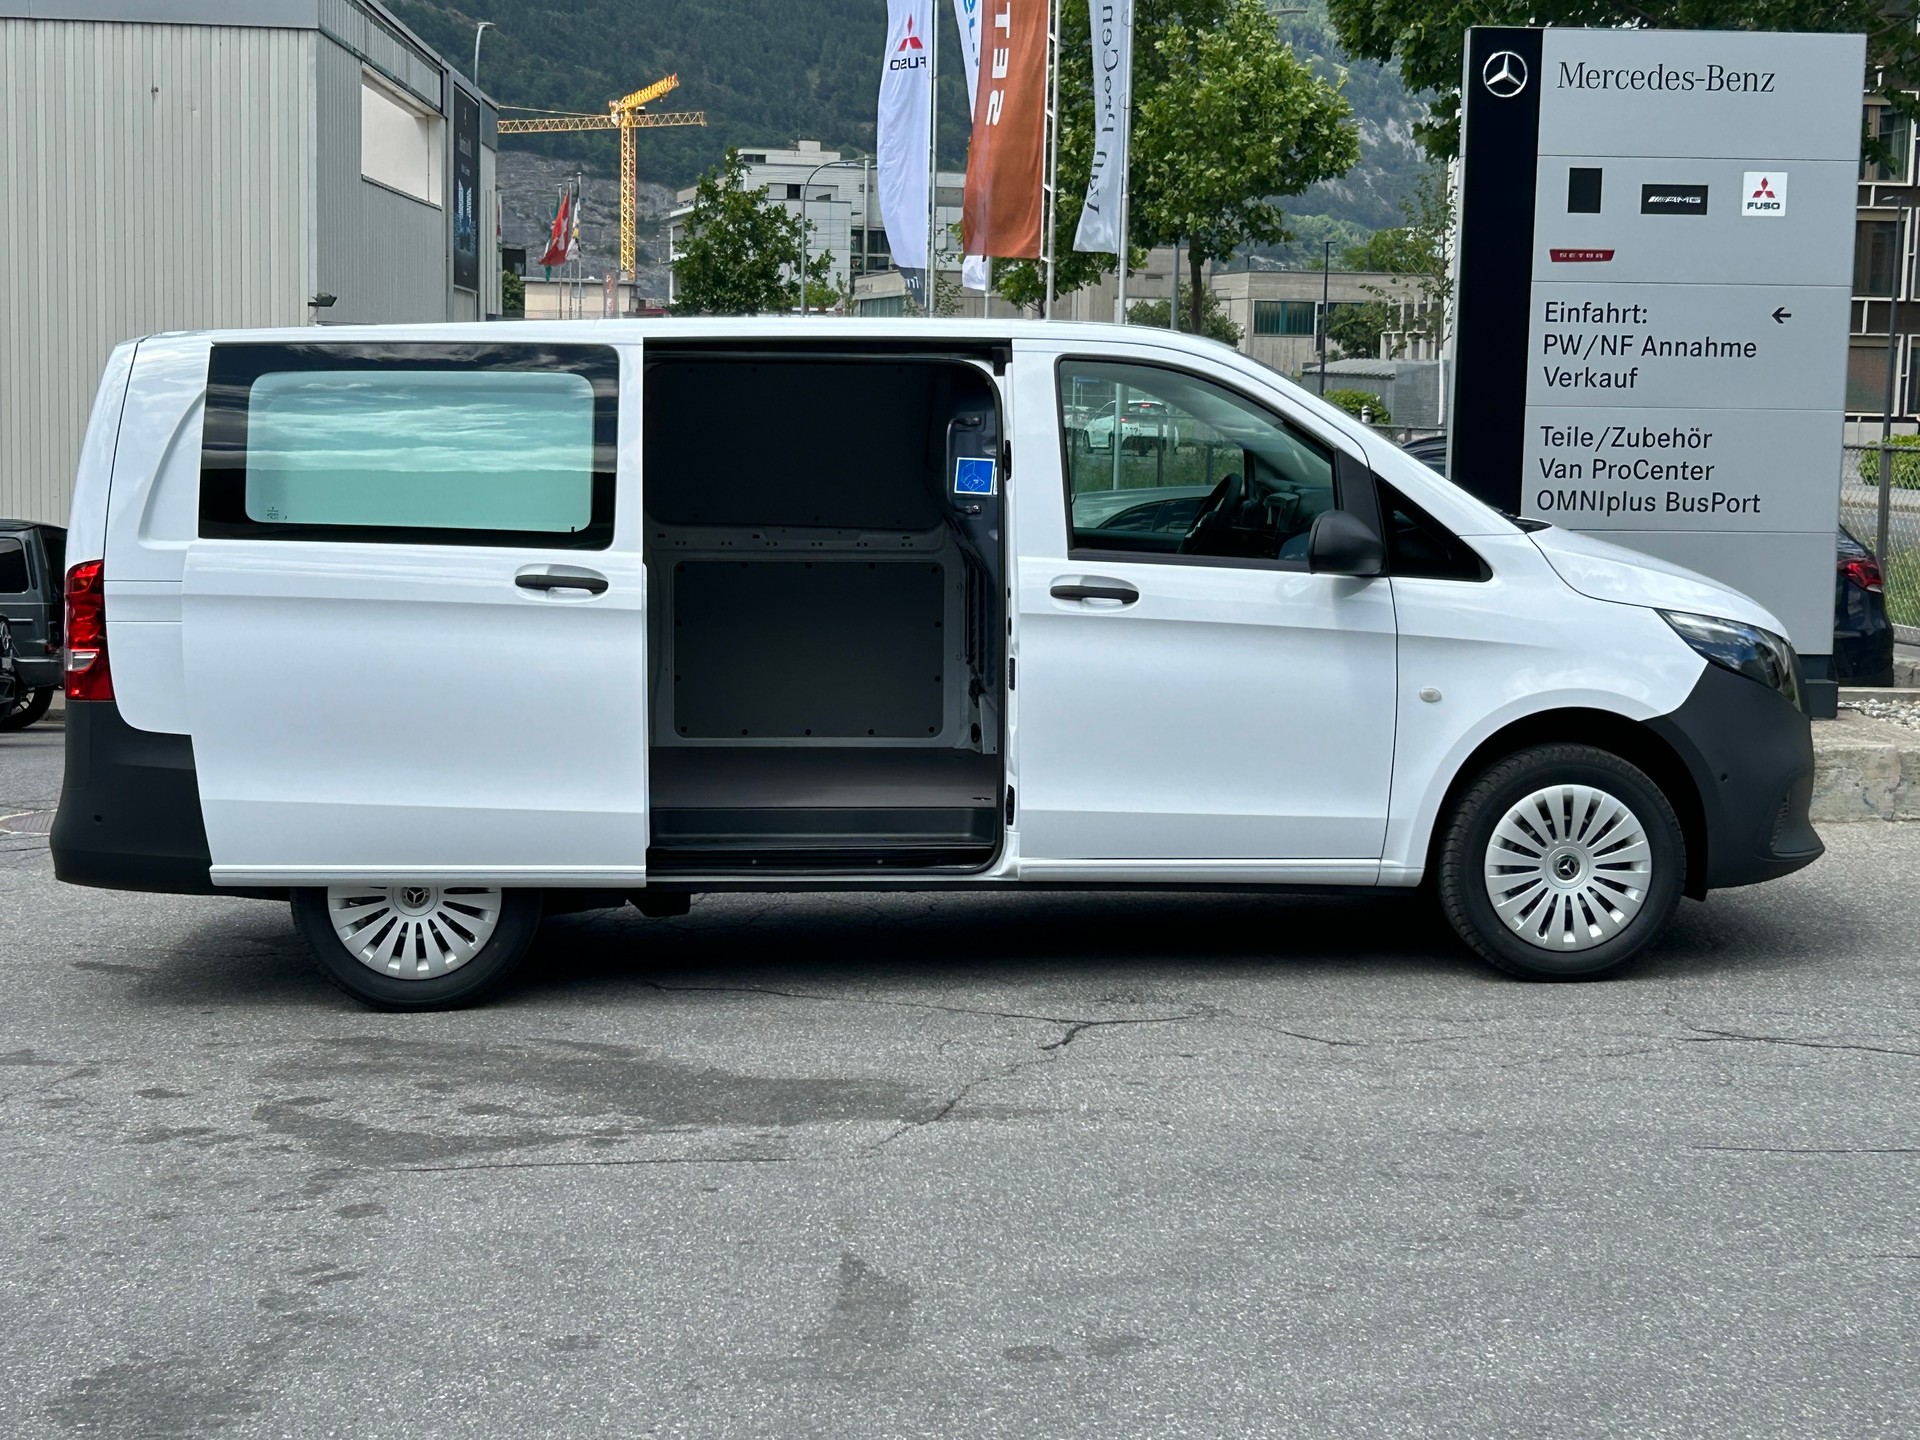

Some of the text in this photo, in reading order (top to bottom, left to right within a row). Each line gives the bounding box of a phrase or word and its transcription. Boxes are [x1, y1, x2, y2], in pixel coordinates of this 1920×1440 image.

[1557, 61, 1775, 93] Mercedes-Benz
[1746, 202, 1781, 210] FUSO
[1545, 301, 1648, 324] Einfahrt:
[1543, 333, 1757, 361] PW/NF Annahme
[1543, 366, 1639, 389] Verkauf
[1540, 425, 1713, 453] Teile/Zubehör
[1538, 457, 1715, 481] Van ProCenter
[1536, 489, 1761, 518] OMNIplus BusPort
